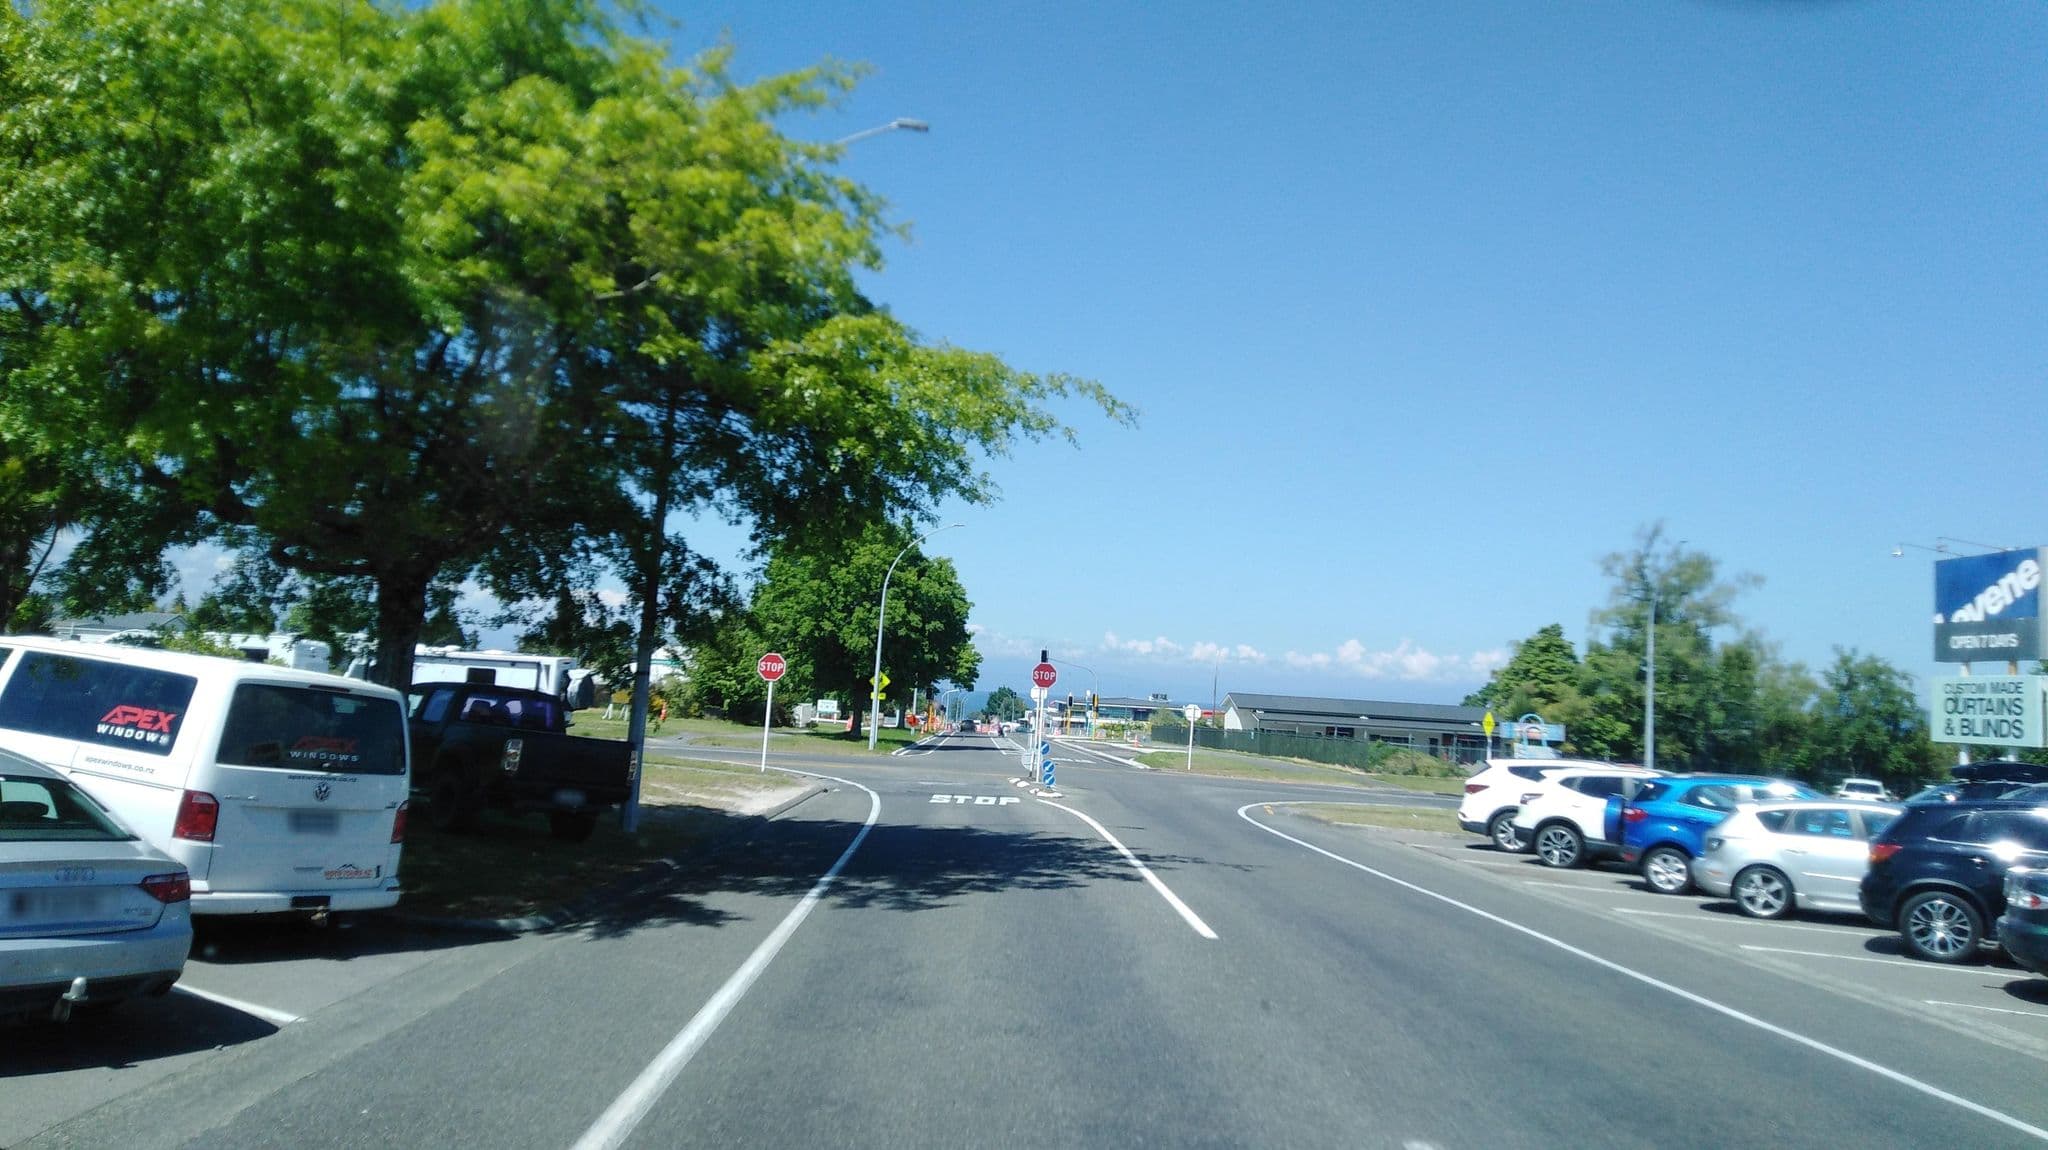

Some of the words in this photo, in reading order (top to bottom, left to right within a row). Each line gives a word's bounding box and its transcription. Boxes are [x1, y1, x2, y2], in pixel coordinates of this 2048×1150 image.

[1949, 635, 1977, 649] OPEN
[760, 660, 784, 672] STOP
[1033, 670, 1056, 680] STOP
[1944, 683, 1986, 695] CUSTOM
[1990, 681, 2024, 694] MADE
[100, 704, 177, 733] APEX
[96, 723, 170, 746] WINDOWS
[1944, 718, 1955, 736] &
[1960, 718, 2024, 740] BLINDS
[289, 751, 360, 762] WINDOWS
[928, 794, 1021, 806] STOP
